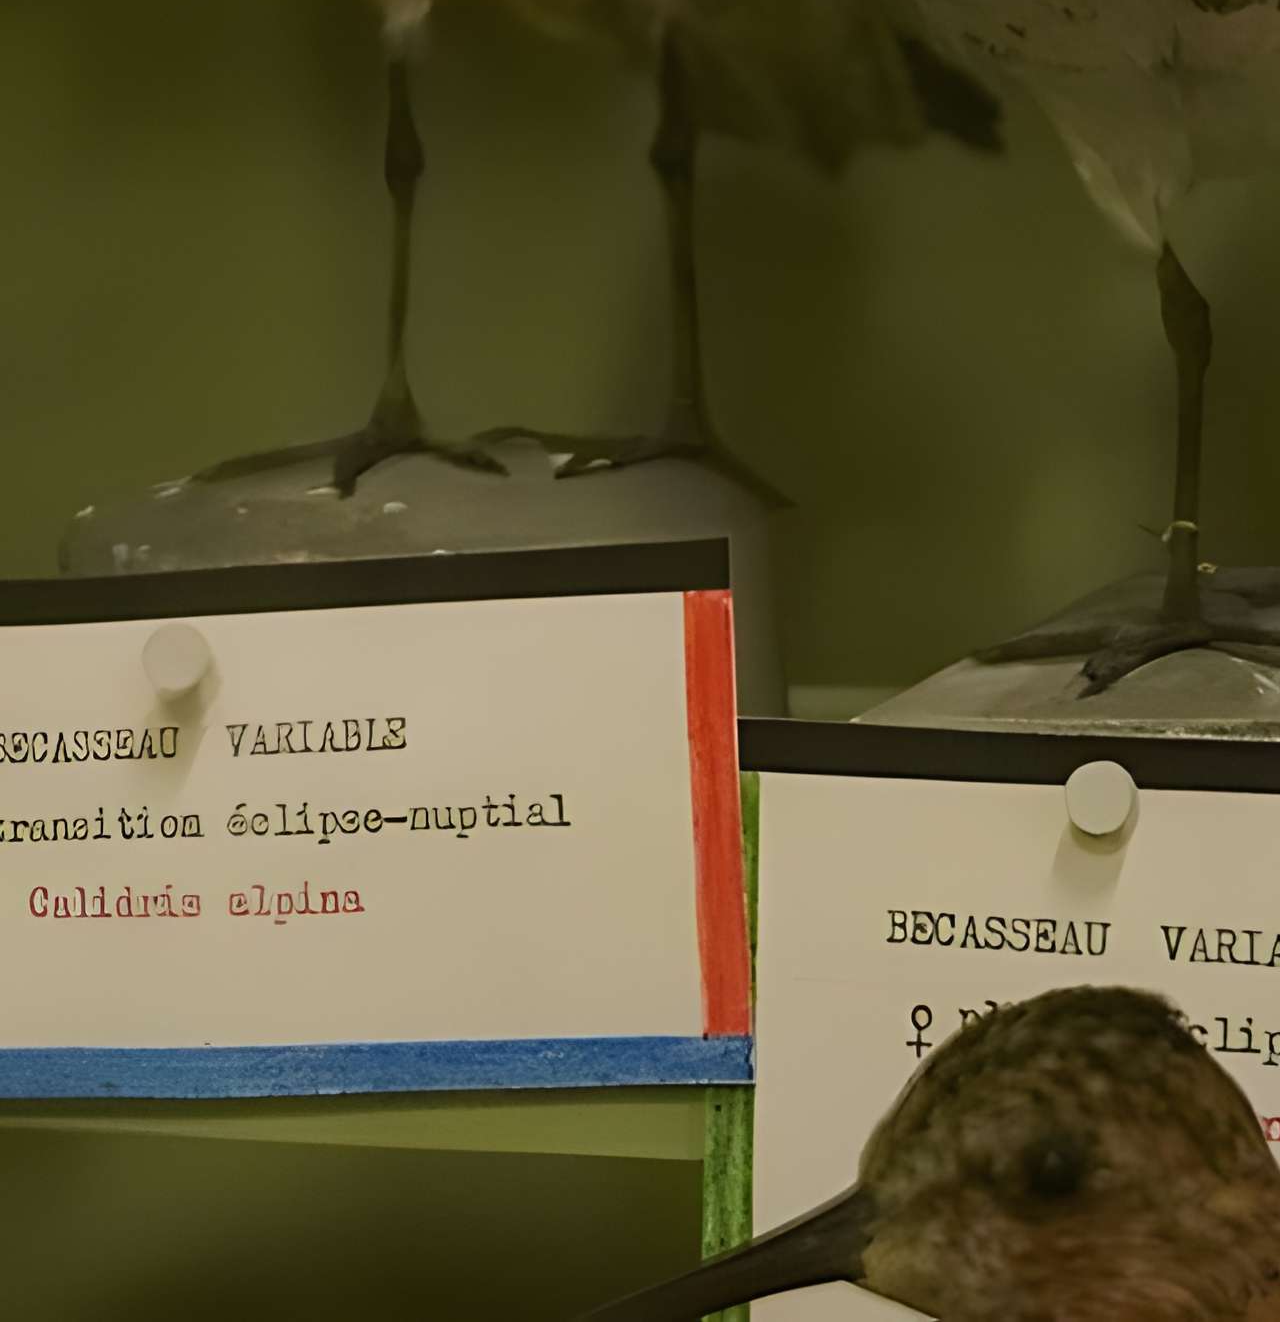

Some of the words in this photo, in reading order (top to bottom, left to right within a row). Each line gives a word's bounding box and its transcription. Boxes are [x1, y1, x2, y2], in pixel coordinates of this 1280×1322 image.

[225, 717, 407, 757] VARIABLE
[227, 793, 572, 845] éclipse-nuptial
[29, 886, 201, 919] Calidris
[228, 881, 366, 925] alpina
[886, 910, 1112, 956] BECASSEAU
